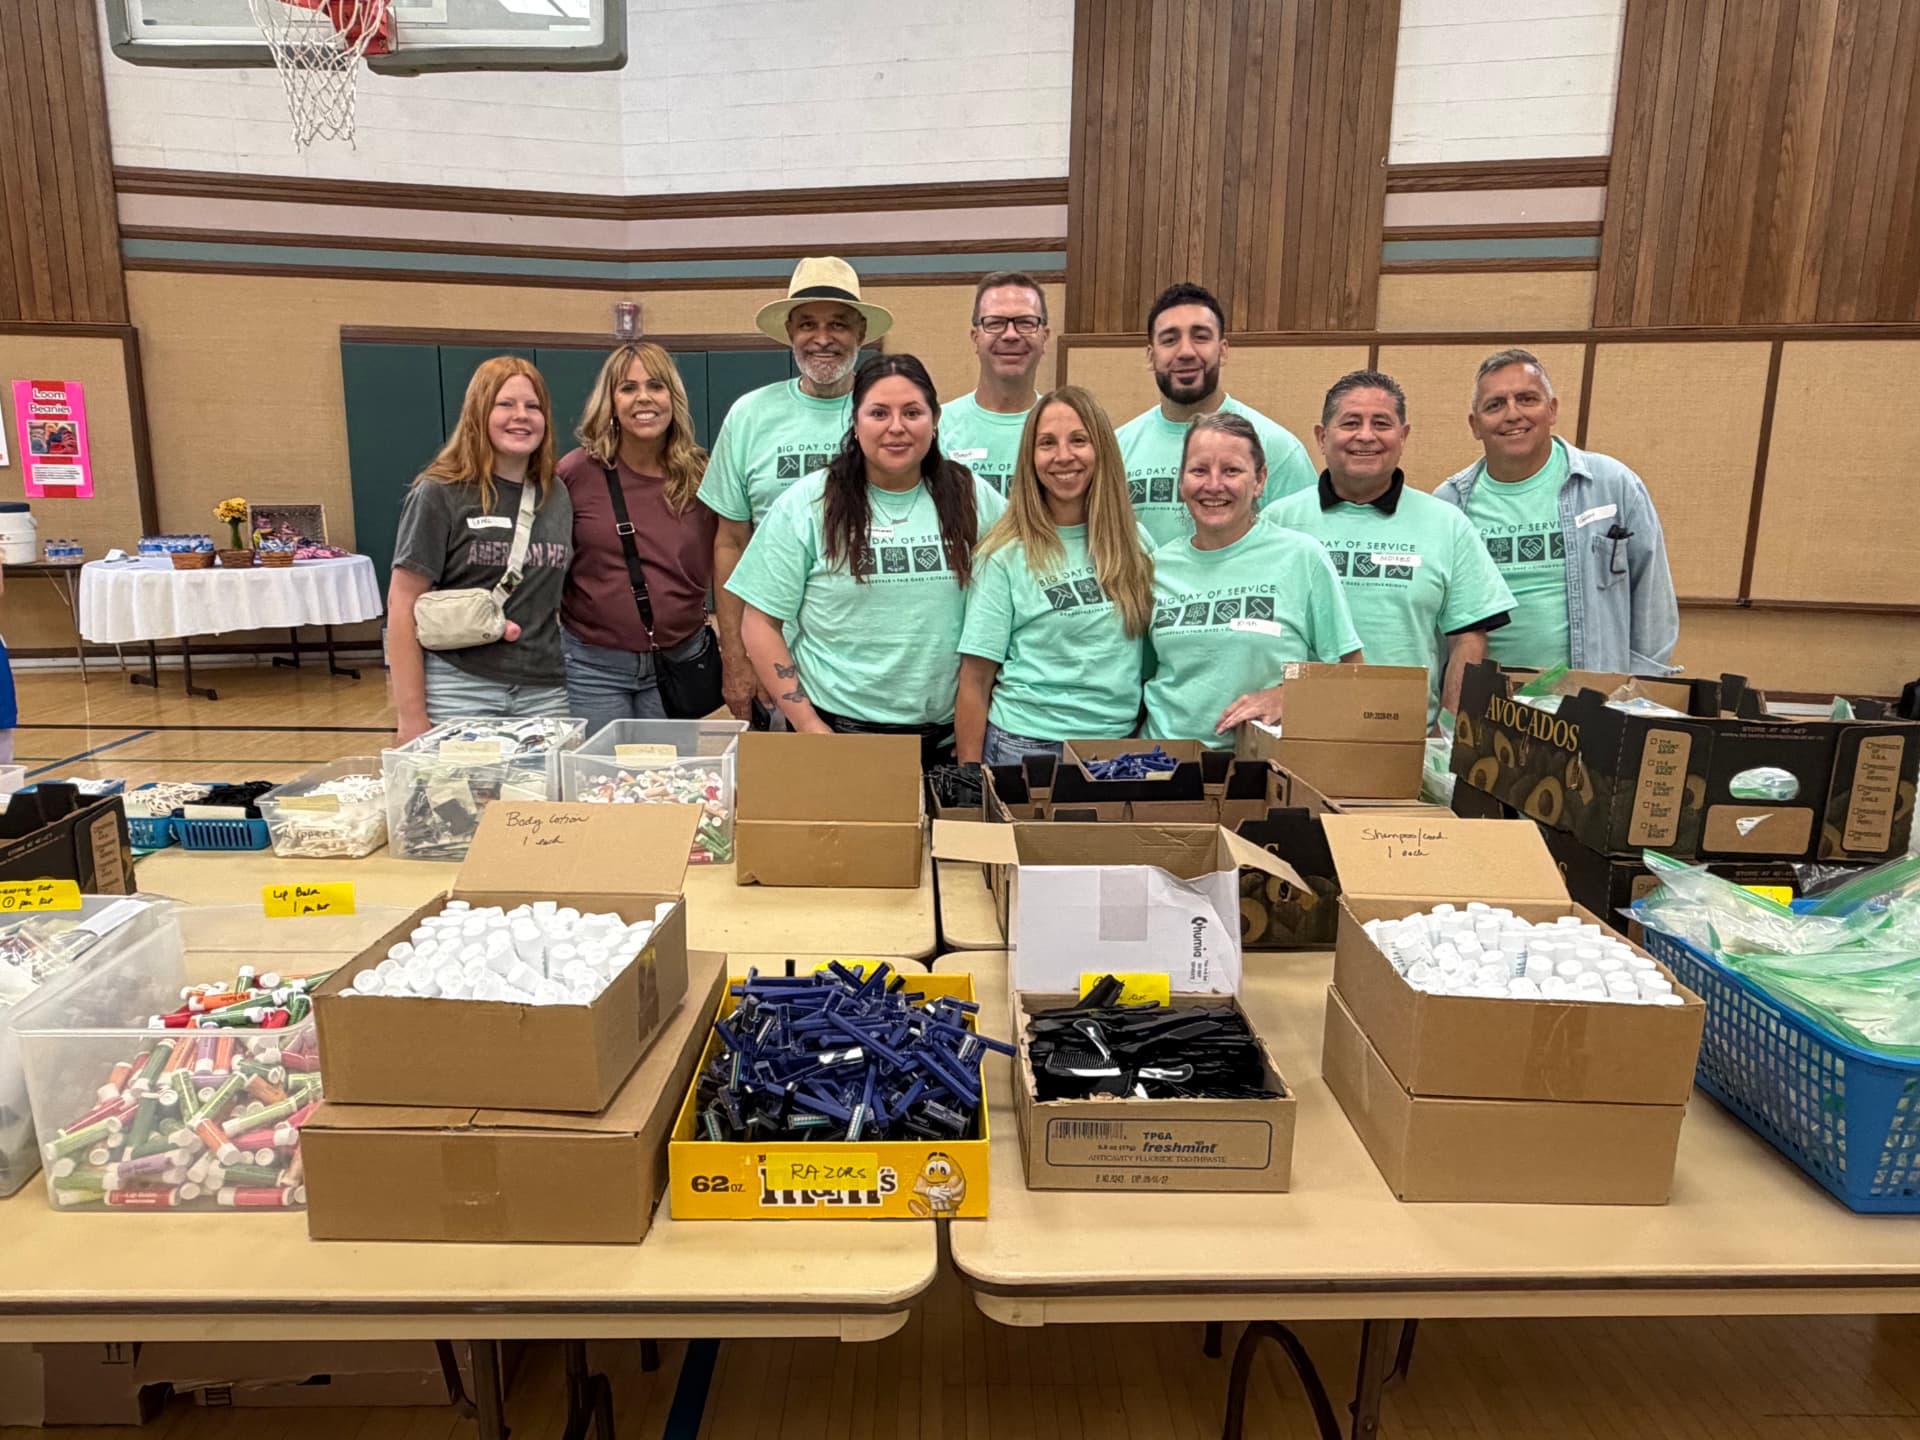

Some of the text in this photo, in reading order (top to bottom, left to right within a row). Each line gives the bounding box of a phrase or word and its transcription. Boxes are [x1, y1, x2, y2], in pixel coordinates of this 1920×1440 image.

[33, 389, 66, 399] Loom
[30, 403, 70, 414] Beanies
[972, 463, 1012, 471] DAY OF
[1127, 469, 1142, 478] BIG
[1147, 467, 1166, 475] DAY
[1481, 527, 1503, 536] DAY
[1508, 525, 1522, 533] OF
[873, 537, 895, 545] DAY
[901, 537, 915, 545] OF
[1346, 541, 1361, 549] OF
[1367, 542, 1416, 552] SERVICE
[467, 541, 543, 567] AMERAN
[1039, 575, 1059, 587] BIG
[1157, 584, 1277, 607] BIG DAY OF SERVICE
[1485, 693, 1580, 752] AVOCADOS
[506, 811, 543, 834] Body
[1143, 1140, 1218, 1154] freshmint
[792, 1164, 867, 1180] RAZORS
[691, 1176, 730, 1193] 62
